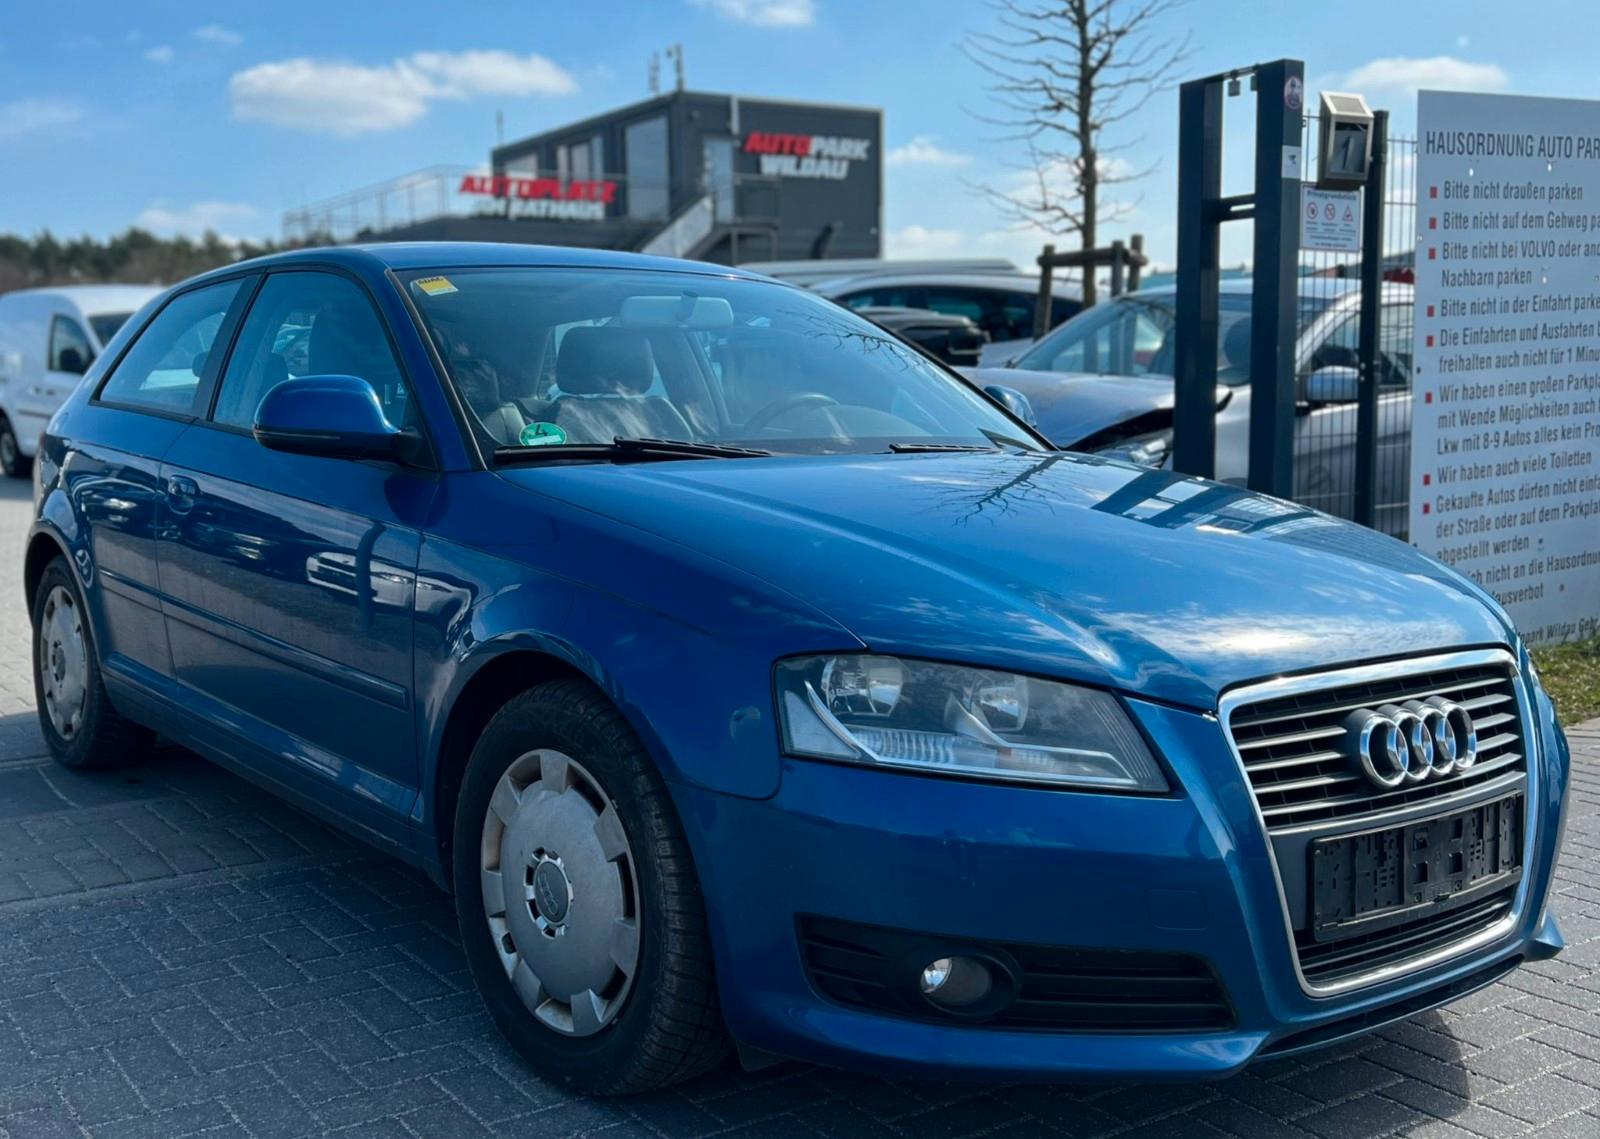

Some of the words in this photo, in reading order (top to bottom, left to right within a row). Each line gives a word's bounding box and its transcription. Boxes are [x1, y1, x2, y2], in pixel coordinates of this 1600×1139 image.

[1426, 131, 1534, 158] HAUSORDNUNG
[1537, 135, 1572, 158] AUTO
[760, 154, 849, 180] WILDAU
[1444, 181, 1470, 200] Bitte
[1473, 182, 1500, 200] nicht
[1503, 182, 1545, 201] draußen
[1549, 183, 1583, 203] parken
[1443, 211, 1469, 230] Bitte
[1472, 212, 1499, 230] nicht
[1502, 211, 1519, 229] auf
[1522, 211, 1544, 229] dem
[1547, 211, 1587, 232] Gehweg
[1442, 242, 1468, 260] Bitte
[1472, 242, 1499, 260] nicht
[1502, 241, 1518, 260] bei
[1520, 240, 1556, 259] VOLVO
[1558, 240, 1581, 258] oder
[1442, 269, 1494, 288] Nachbarn
[1497, 268, 1532, 288] parken
[1441, 299, 1467, 318] Bitte
[1470, 298, 1497, 317] nicht
[1500, 298, 1510, 315] in
[1513, 296, 1529, 314] der
[1533, 294, 1571, 313] Einfahrt
[1440, 328, 1459, 347] Die
[1463, 327, 1517, 346] Einfahrten
[1520, 325, 1538, 342] und
[1541, 322, 1594, 341] Ausfahrten
[1439, 354, 1492, 374] freihalten
[1495, 351, 1520, 369] auch
[1523, 349, 1548, 367] nicht
[1550, 348, 1564, 365] für
[1567, 348, 1573, 363] 1
[1439, 384, 1459, 403] Wir
[1462, 381, 1495, 401] haben
[1499, 379, 1527, 397] einen
[1529, 376, 1564, 398] großen
[1438, 410, 1456, 429] mit
[1459, 407, 1496, 427] Wende
[1499, 400, 1570, 425] Möglichkeiten
[1572, 397, 1595, 416] auch
[536, 423, 548, 436] 4
[1437, 438, 1460, 456] Lkw
[1462, 434, 1480, 453] mit
[1483, 431, 1500, 450] 8-9
[1502, 430, 1531, 448] Autos
[1534, 426, 1558, 445] alles
[1561, 423, 1582, 442] kein
[1437, 466, 1456, 484] Wir
[1460, 462, 1493, 481] haben
[1495, 458, 1520, 477] auch
[1523, 455, 1547, 473] viele
[1550, 451, 1592, 470] Toiletten
[1436, 491, 1484, 514] Gekaufte
[1487, 489, 1515, 507] Autos
[1518, 482, 1550, 504] dürfen
[1552, 479, 1578, 498] nicht
[1436, 520, 1454, 539] der
[1457, 514, 1492, 536] Straße
[1495, 511, 1517, 530] oder
[1520, 508, 1537, 526] auf
[1539, 505, 1560, 523] dem
[1493, 535, 1530, 555] werden
[1486, 565, 1511, 583] nicht
[1514, 564, 1526, 579] an
[1529, 559, 1544, 576] die
[1547, 621, 1576, 638] Wildau
